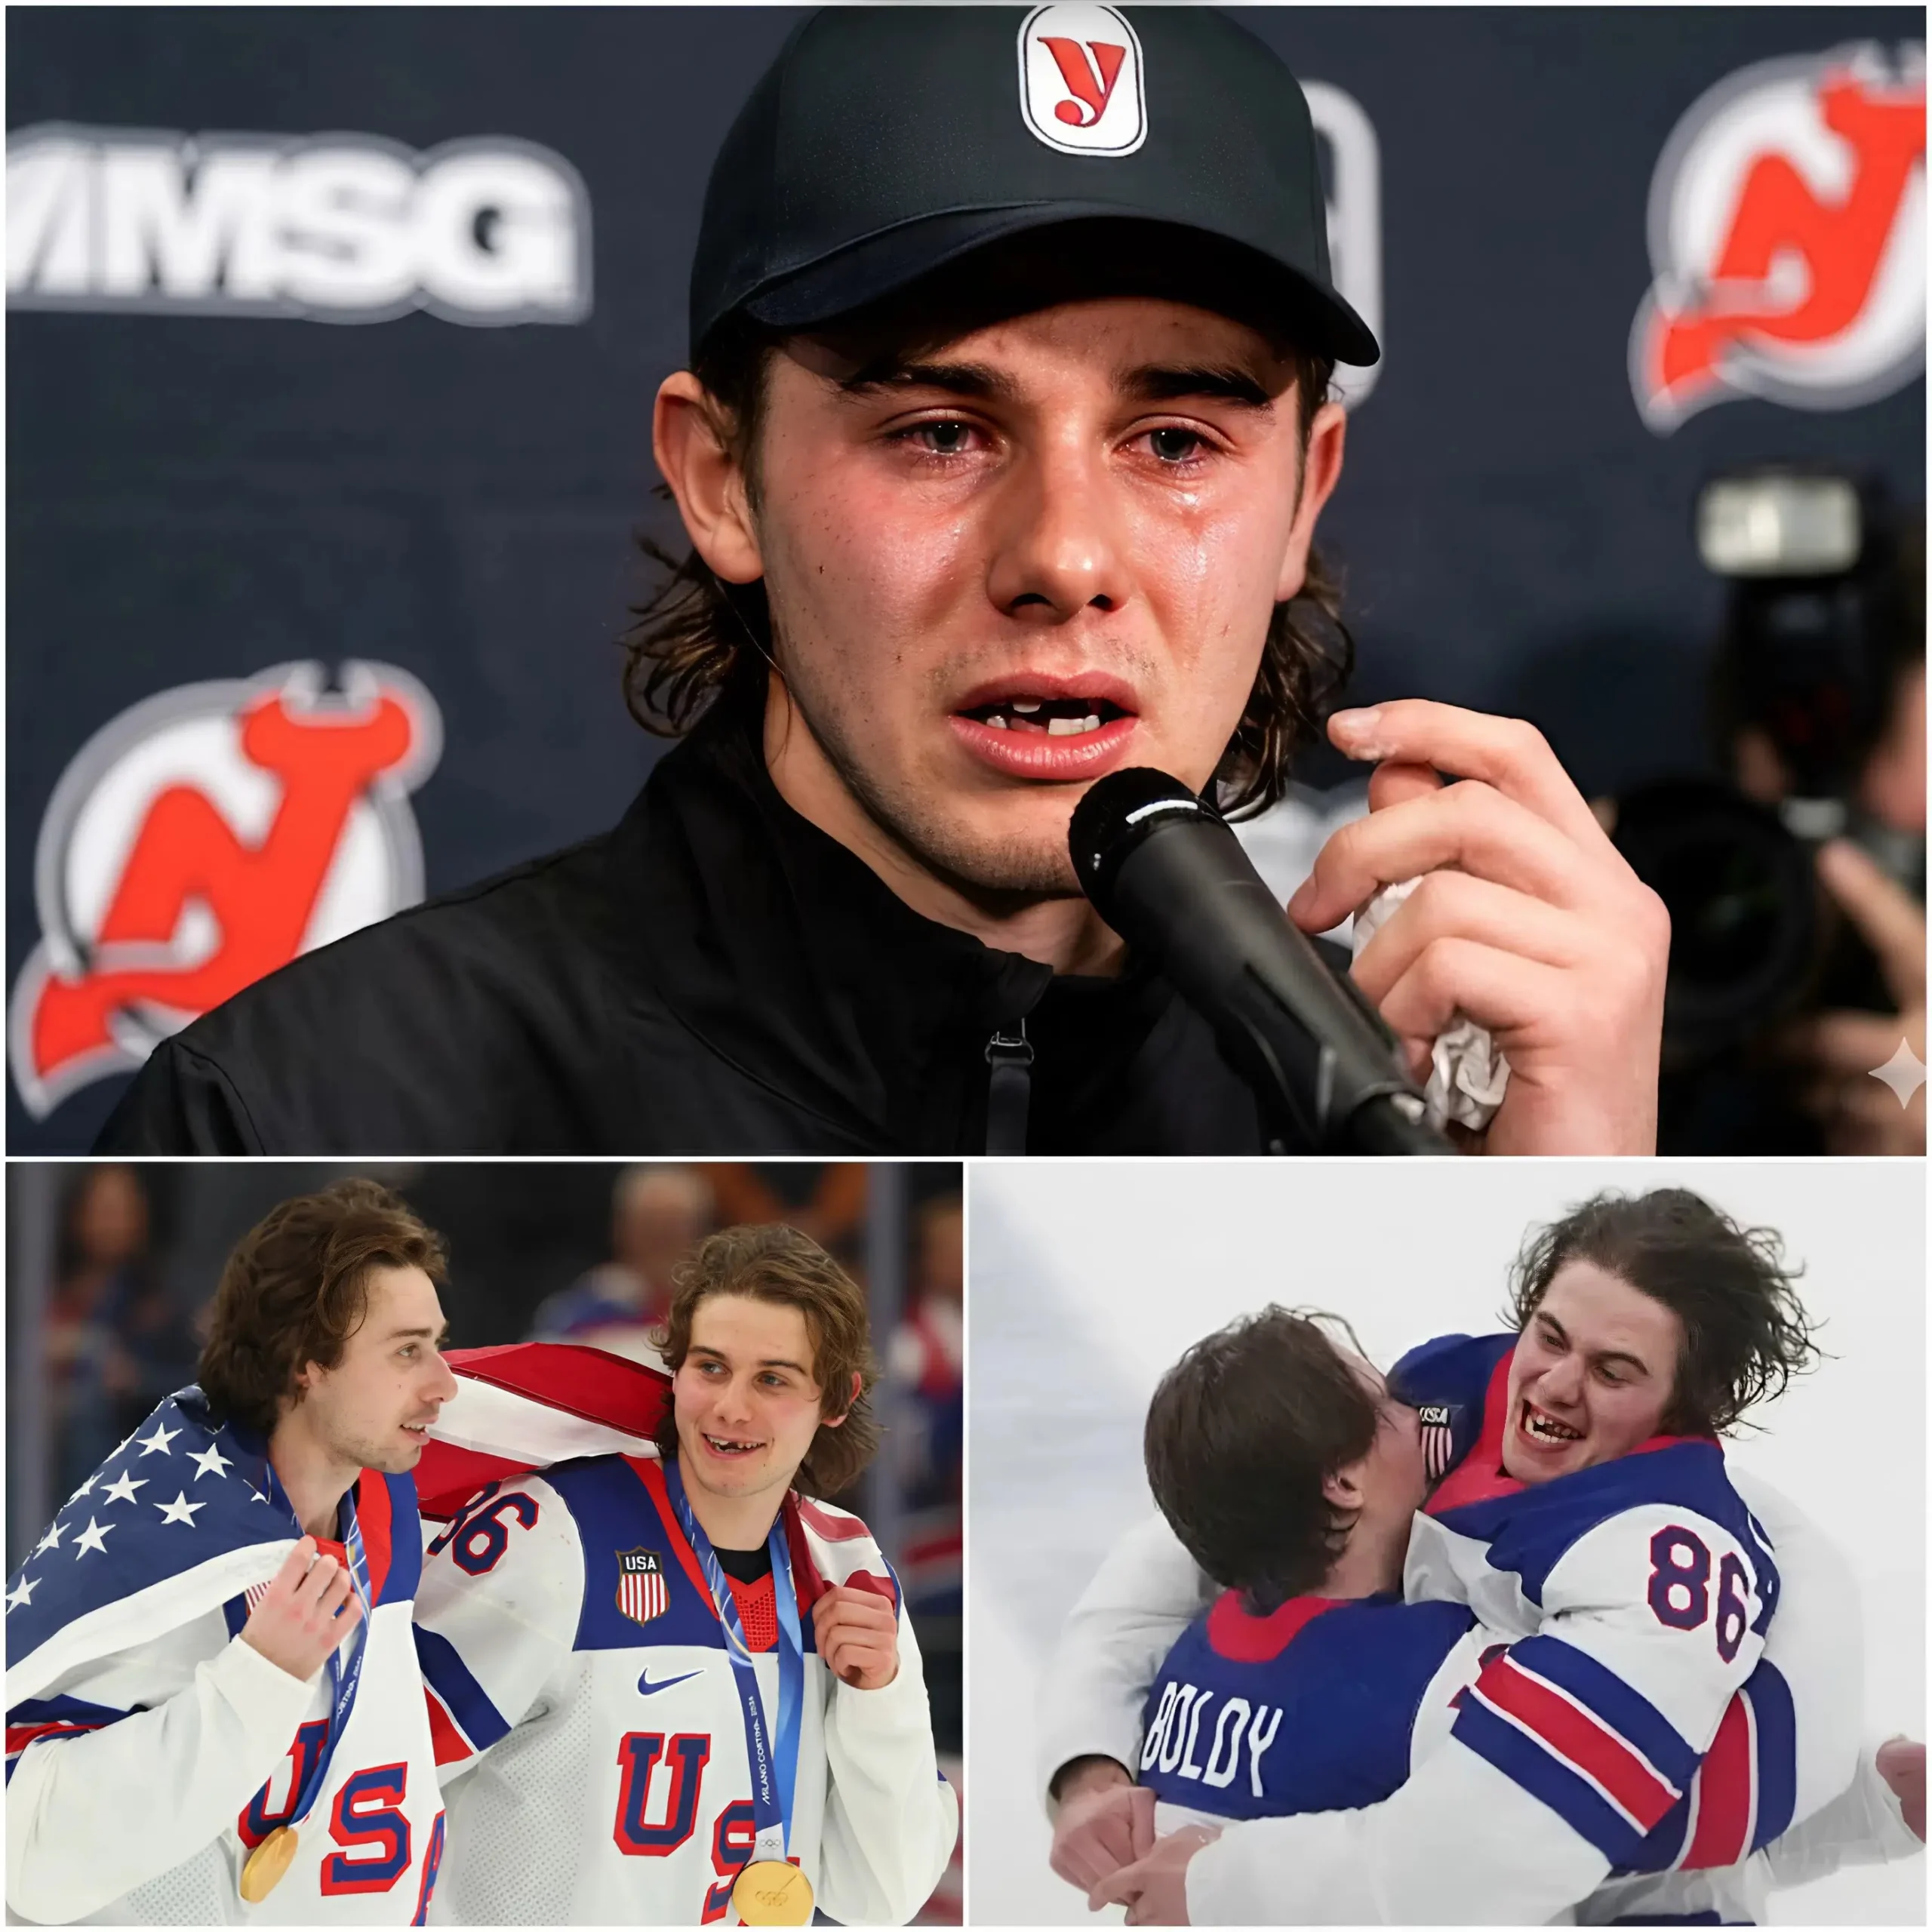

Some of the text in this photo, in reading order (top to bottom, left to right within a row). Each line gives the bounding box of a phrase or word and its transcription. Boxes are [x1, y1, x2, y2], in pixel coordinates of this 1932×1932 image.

[625, 1555, 657, 1571] USA
[1647, 1524, 1750, 1665] 86
[1140, 1681, 1283, 1798] BOLDY
